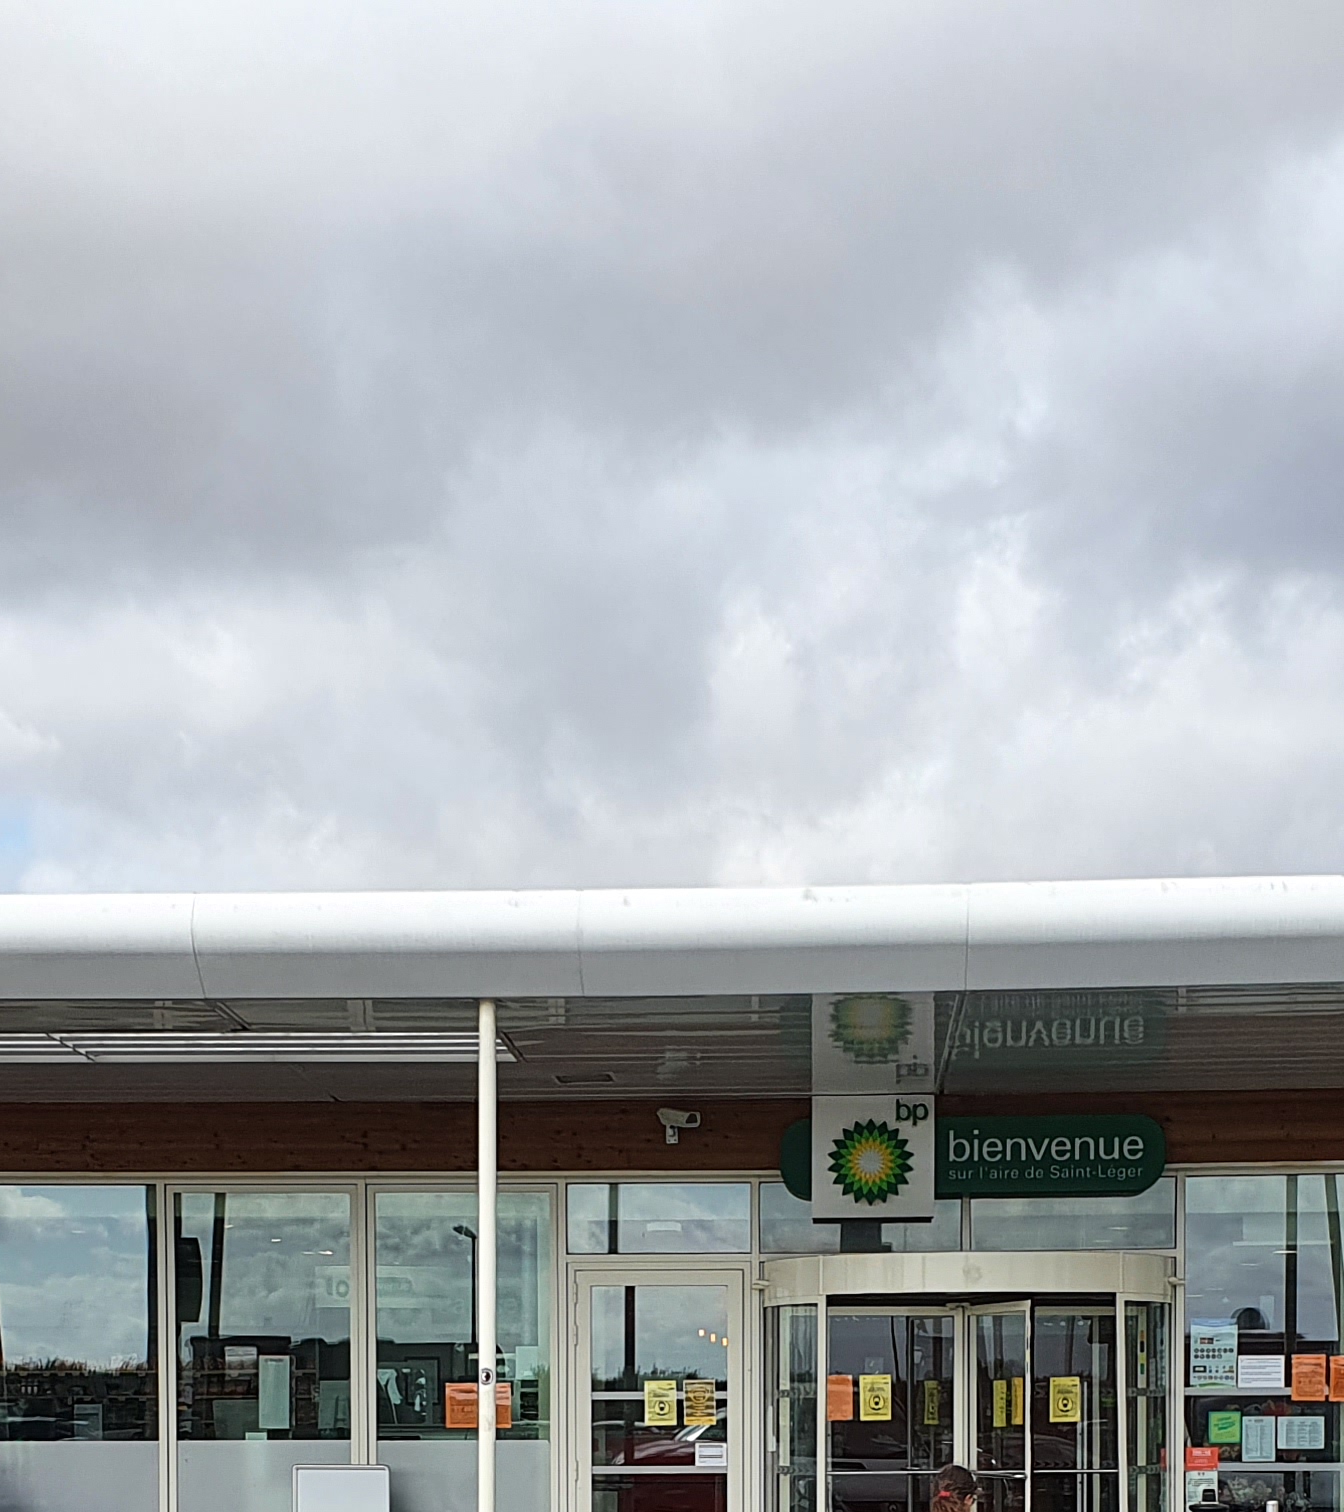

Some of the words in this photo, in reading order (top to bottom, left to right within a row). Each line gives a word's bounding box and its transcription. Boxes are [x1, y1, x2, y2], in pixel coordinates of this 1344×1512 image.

[895, 1099, 929, 1126] bp
[948, 1129, 1144, 1162] bienvenue
[948, 1169, 974, 1180] sur
[979, 1166, 1019, 1180] l'aire
[1024, 1166, 1044, 1179] de
[1050, 1164, 1144, 1181] Saint-Léger
